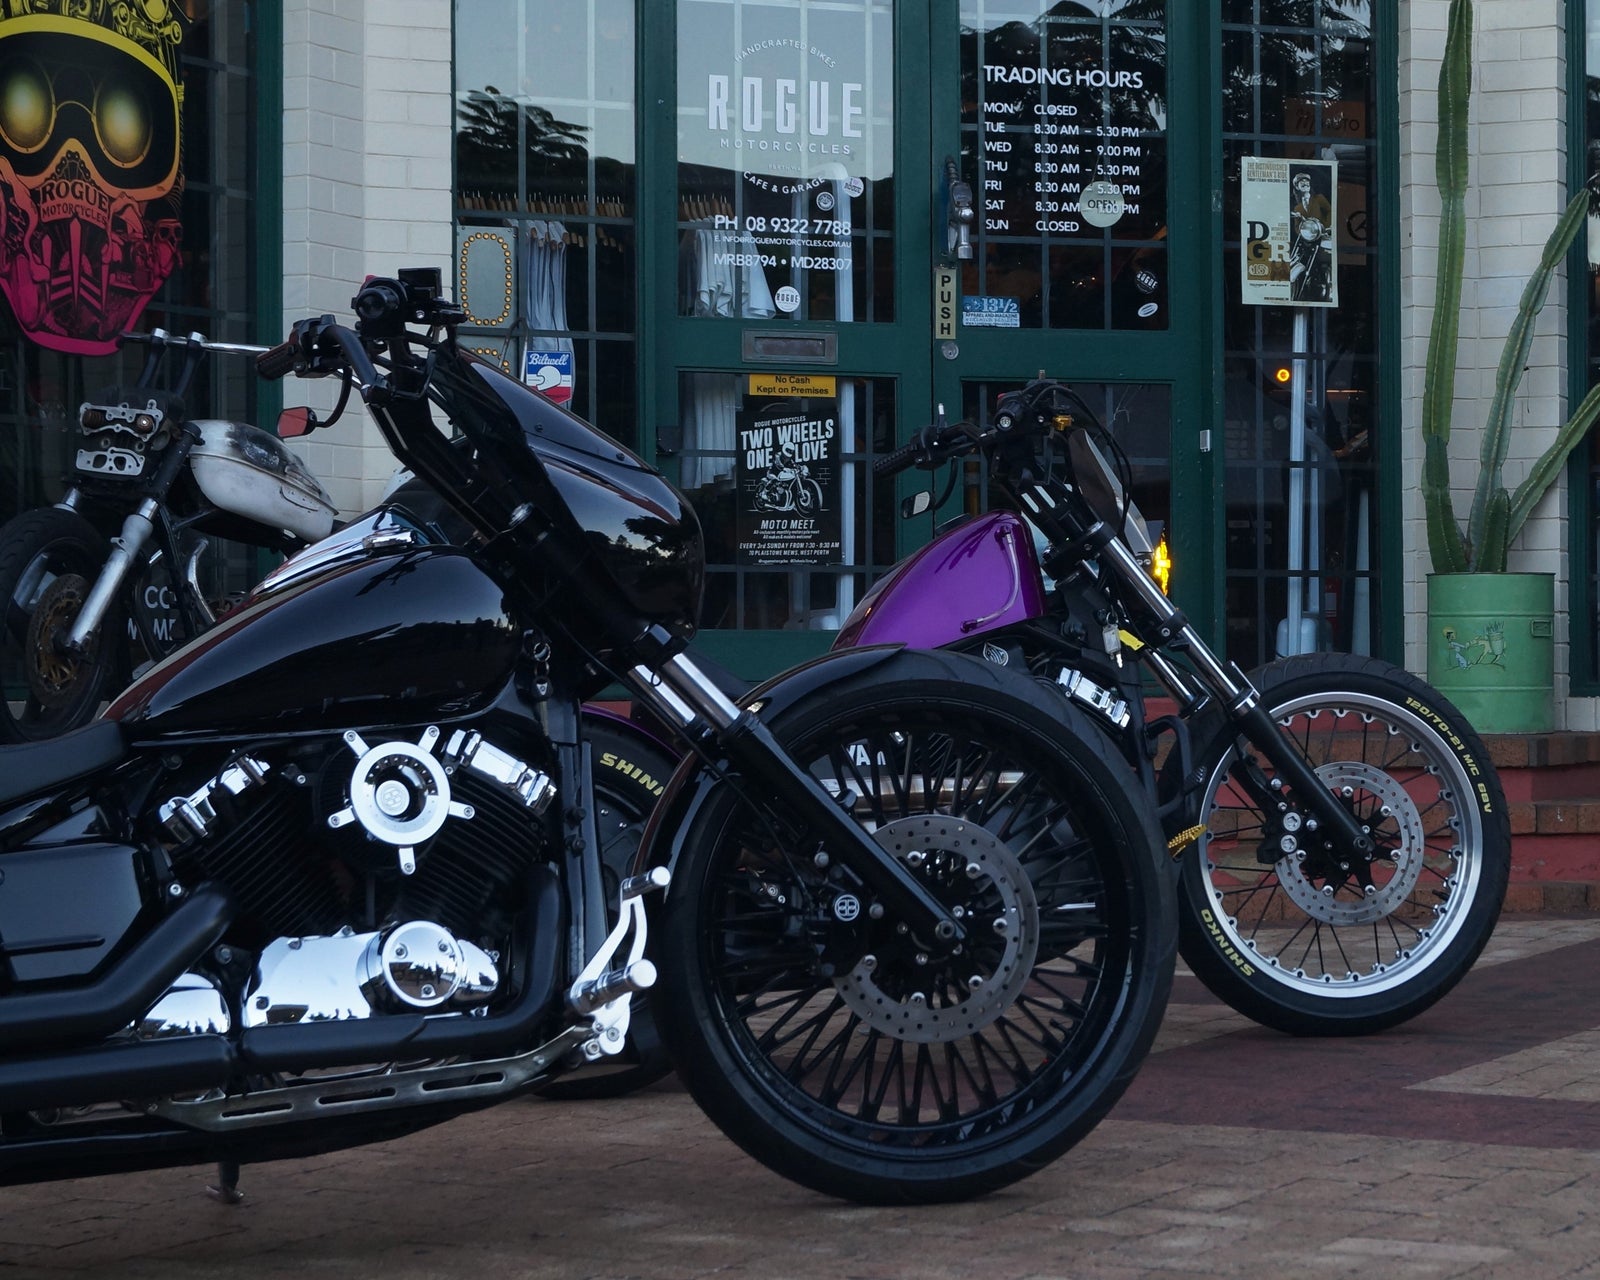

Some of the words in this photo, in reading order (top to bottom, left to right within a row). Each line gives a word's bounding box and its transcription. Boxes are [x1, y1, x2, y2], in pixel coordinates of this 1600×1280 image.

[734, 39, 807, 62] HANDCRAFTED
[810, 46, 836, 68] BIKES
[983, 65, 1072, 86] TRADING
[1076, 69, 1143, 88] HOURS
[708, 74, 862, 138] ROGUE
[984, 102, 1014, 114] MON
[1034, 104, 1078, 116] CLOSED
[985, 121, 1006, 133] TUE
[1034, 124, 1058, 135] 8.30
[1059, 125, 1080, 135] AM
[1096, 127, 1120, 137] 5.30
[1121, 127, 1140, 138] PM
[720, 138, 851, 155] MOTORCYCLES
[984, 141, 1012, 152] WED
[1034, 143, 1058, 154] 8.30
[1060, 144, 1080, 154] AM
[1097, 145, 1121, 156] 9.00
[1123, 146, 1141, 157] PM
[985, 160, 1008, 172] THU
[1034, 162, 1058, 173] 8.30
[1060, 163, 1080, 174] AM
[1097, 165, 1120, 175] 5.30
[1122, 165, 1140, 176] PM
[743, 170, 768, 190] CAFE
[771, 185, 778, 193] &
[782, 176, 825, 194] GARAGE
[985, 180, 1002, 191] FRI
[1035, 181, 1058, 193] 8.30
[1060, 183, 1080, 193] AM
[1097, 184, 1120, 195] 5.30
[1122, 185, 1140, 195] PM
[41, 180, 109, 212] ROGUE
[42, 203, 108, 224] MOTORCYCLES
[985, 199, 1006, 210] SAT
[1035, 201, 1058, 212] 8.30
[1061, 202, 1080, 212] AM
[1122, 203, 1140, 215] PM
[714, 214, 738, 230] PH
[746, 216, 766, 232] 08
[770, 217, 808, 233] 9322
[813, 219, 852, 236] 7788
[985, 219, 1009, 230] SUN
[1035, 220, 1079, 232] CLOSED
[714, 253, 777, 267] MRB8794
[791, 256, 852, 270] MD28307
[776, 293, 798, 303] ROGUE
[940, 275, 951, 335] PUSH
[528, 353, 569, 365] Biltwell
[775, 375, 787, 383] No
[789, 376, 810, 384] Cash
[756, 385, 776, 394] Kept
[791, 386, 829, 394] Premises
[754, 419, 770, 428] ROGUE
[771, 415, 806, 425] MOTORCYCLES
[740, 427, 773, 451] TWO
[777, 418, 834, 445] WHEELS
[746, 447, 774, 470] ONE
[794, 439, 828, 463] LOVE
[760, 519, 788, 529] MOTO
[790, 519, 815, 529] MEET
[1405, 697, 1465, 751] 120/70-21
[1463, 753, 1480, 776] M/C
[1201, 908, 1255, 976] SHINKO
